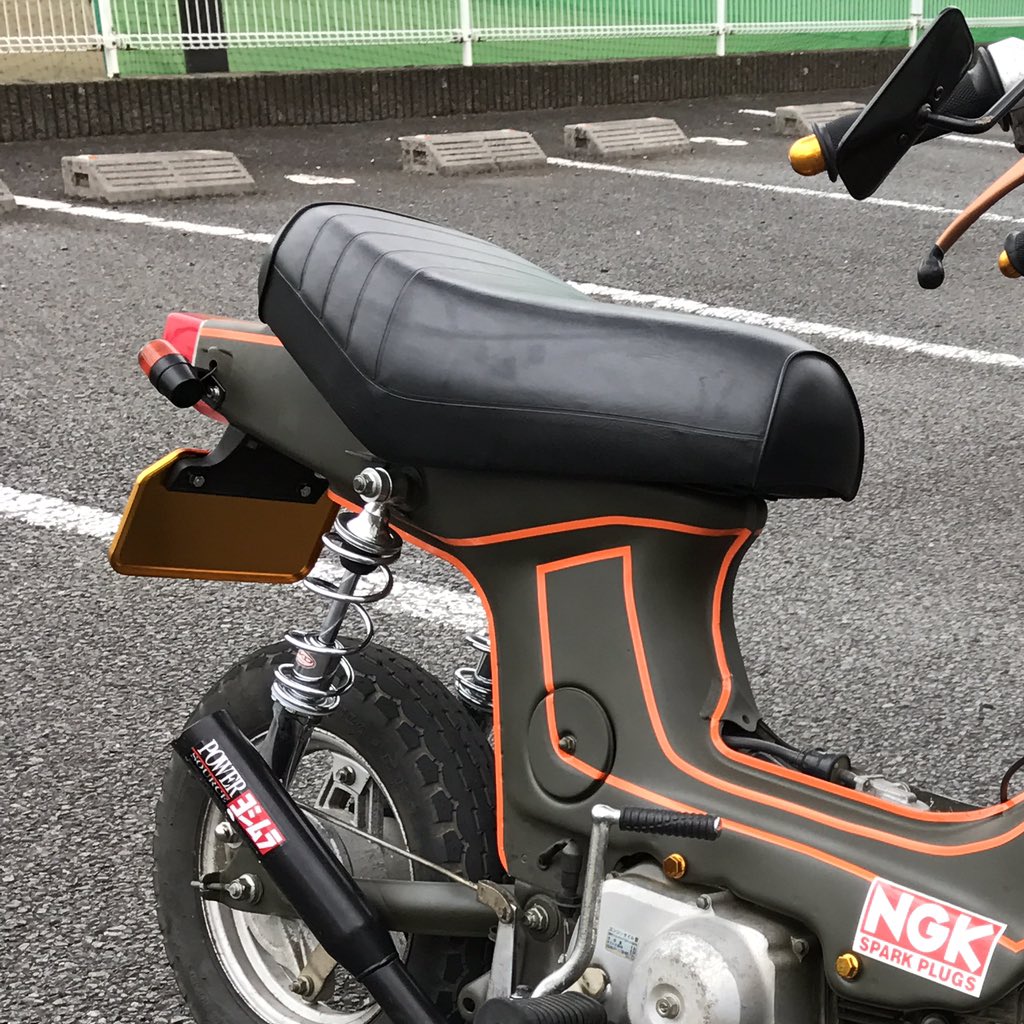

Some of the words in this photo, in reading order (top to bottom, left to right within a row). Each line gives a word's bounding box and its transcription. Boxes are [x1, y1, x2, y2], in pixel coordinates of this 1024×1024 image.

[199, 739, 247, 798] POWER
[229, 792, 284, 851] ヨシムラ
[863, 883, 995, 973] NGK
[859, 936, 912, 968] SPARK
[917, 959, 977, 992] PLUGS
